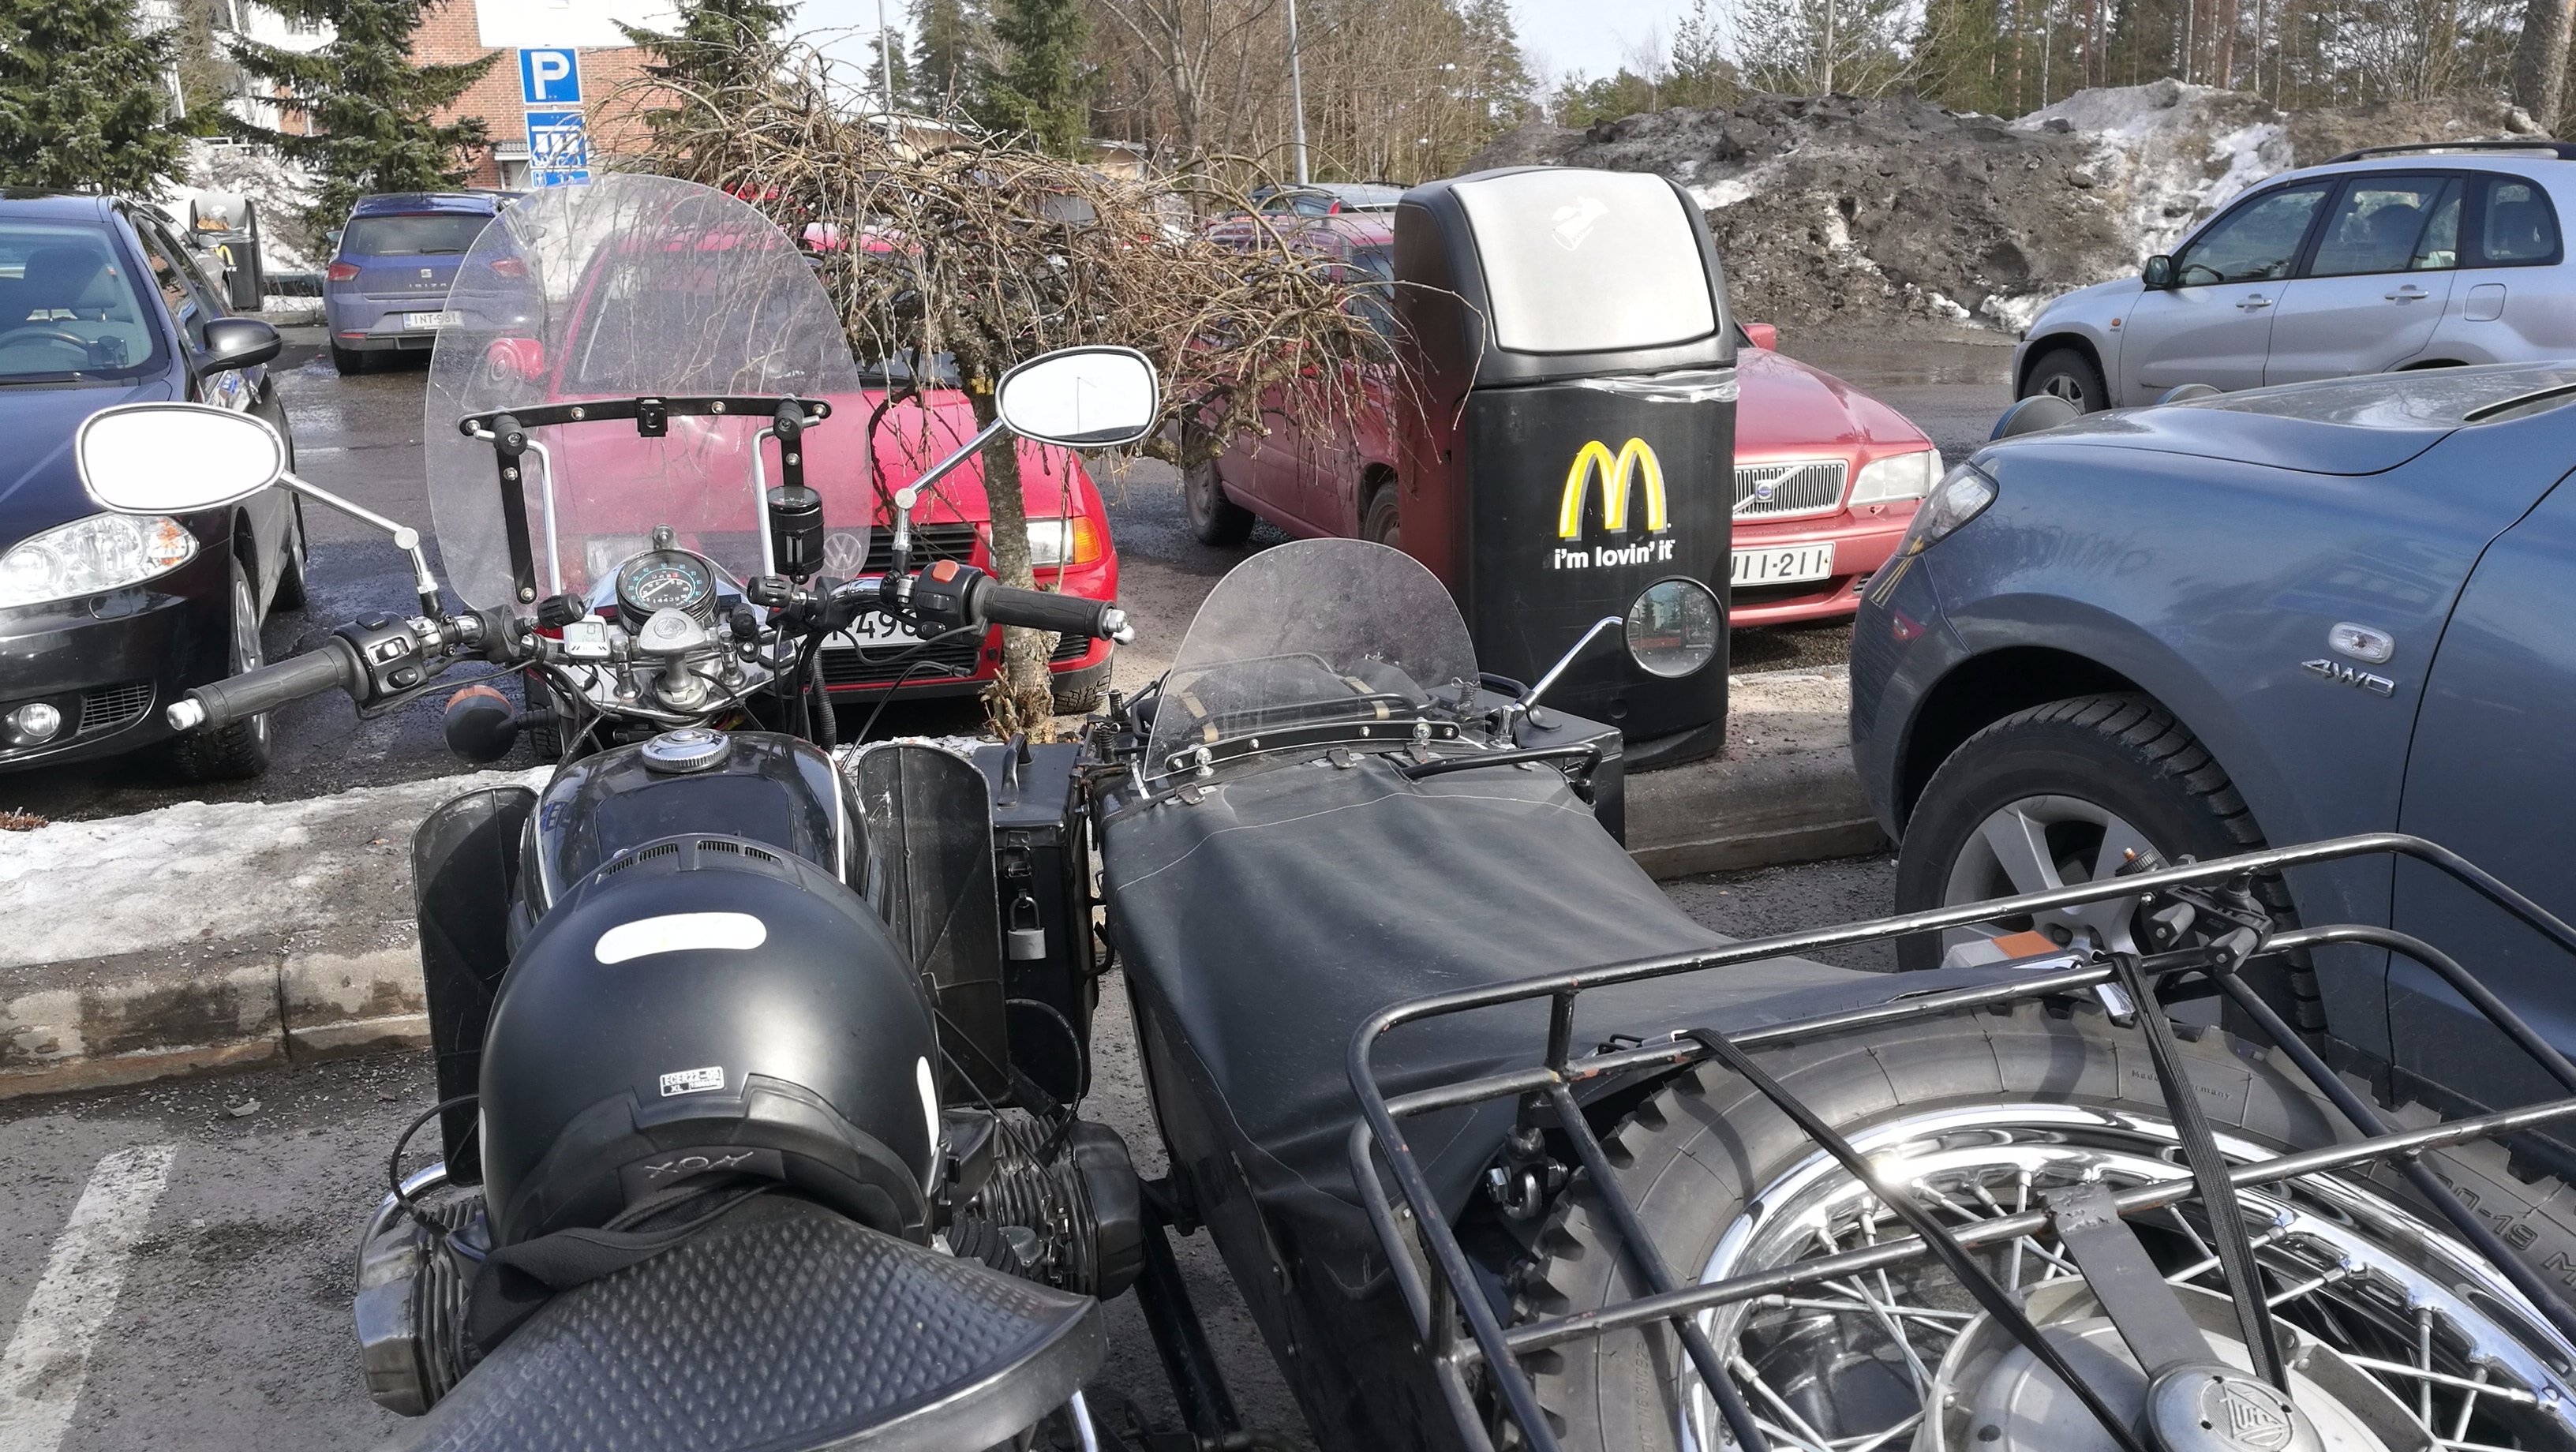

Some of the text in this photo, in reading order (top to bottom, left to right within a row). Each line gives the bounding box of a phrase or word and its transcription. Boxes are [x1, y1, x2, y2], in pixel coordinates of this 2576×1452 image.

[530, 51, 571, 100] P
[1555, 548, 1589, 570] i'm
[1595, 541, 1656, 567] lovin'
[2301, 658, 2395, 698] 4WD
[670, 1084, 683, 1093] XL
